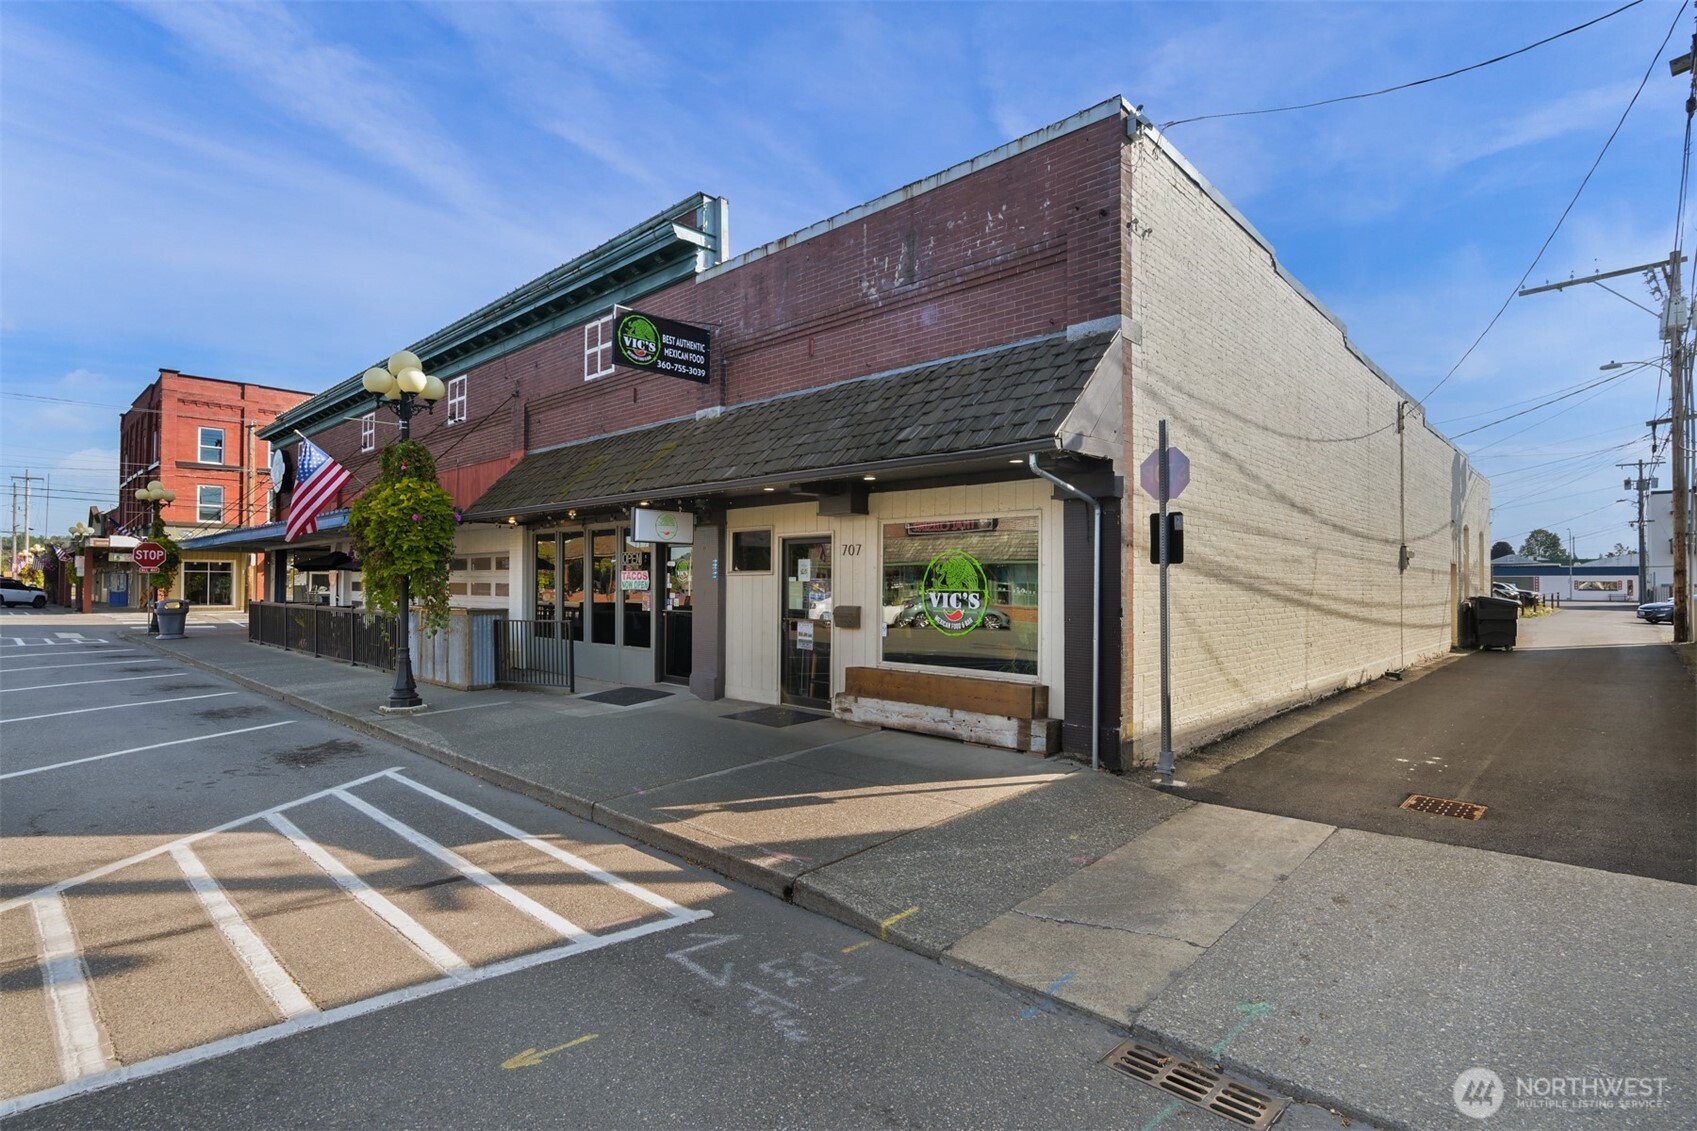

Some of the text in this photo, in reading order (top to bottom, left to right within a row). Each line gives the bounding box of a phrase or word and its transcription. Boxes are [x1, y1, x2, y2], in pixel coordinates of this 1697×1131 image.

[623, 335, 656, 352] VIC'S
[662, 334, 706, 353] BEST AUTHENTIC
[664, 348, 688, 360] MEXICAN
[689, 353, 705, 364] FOOD
[657, 360, 706, 377] 360-755-3039
[135, 550, 164, 560] STOP
[842, 544, 862, 556] 707
[622, 572, 648, 580] TACOS
[622, 581, 649, 589] NOW OPEN
[929, 592, 981, 609] VIC'S
[934, 615, 951, 629] MEXICAN
[965, 617, 974, 627] BAR
